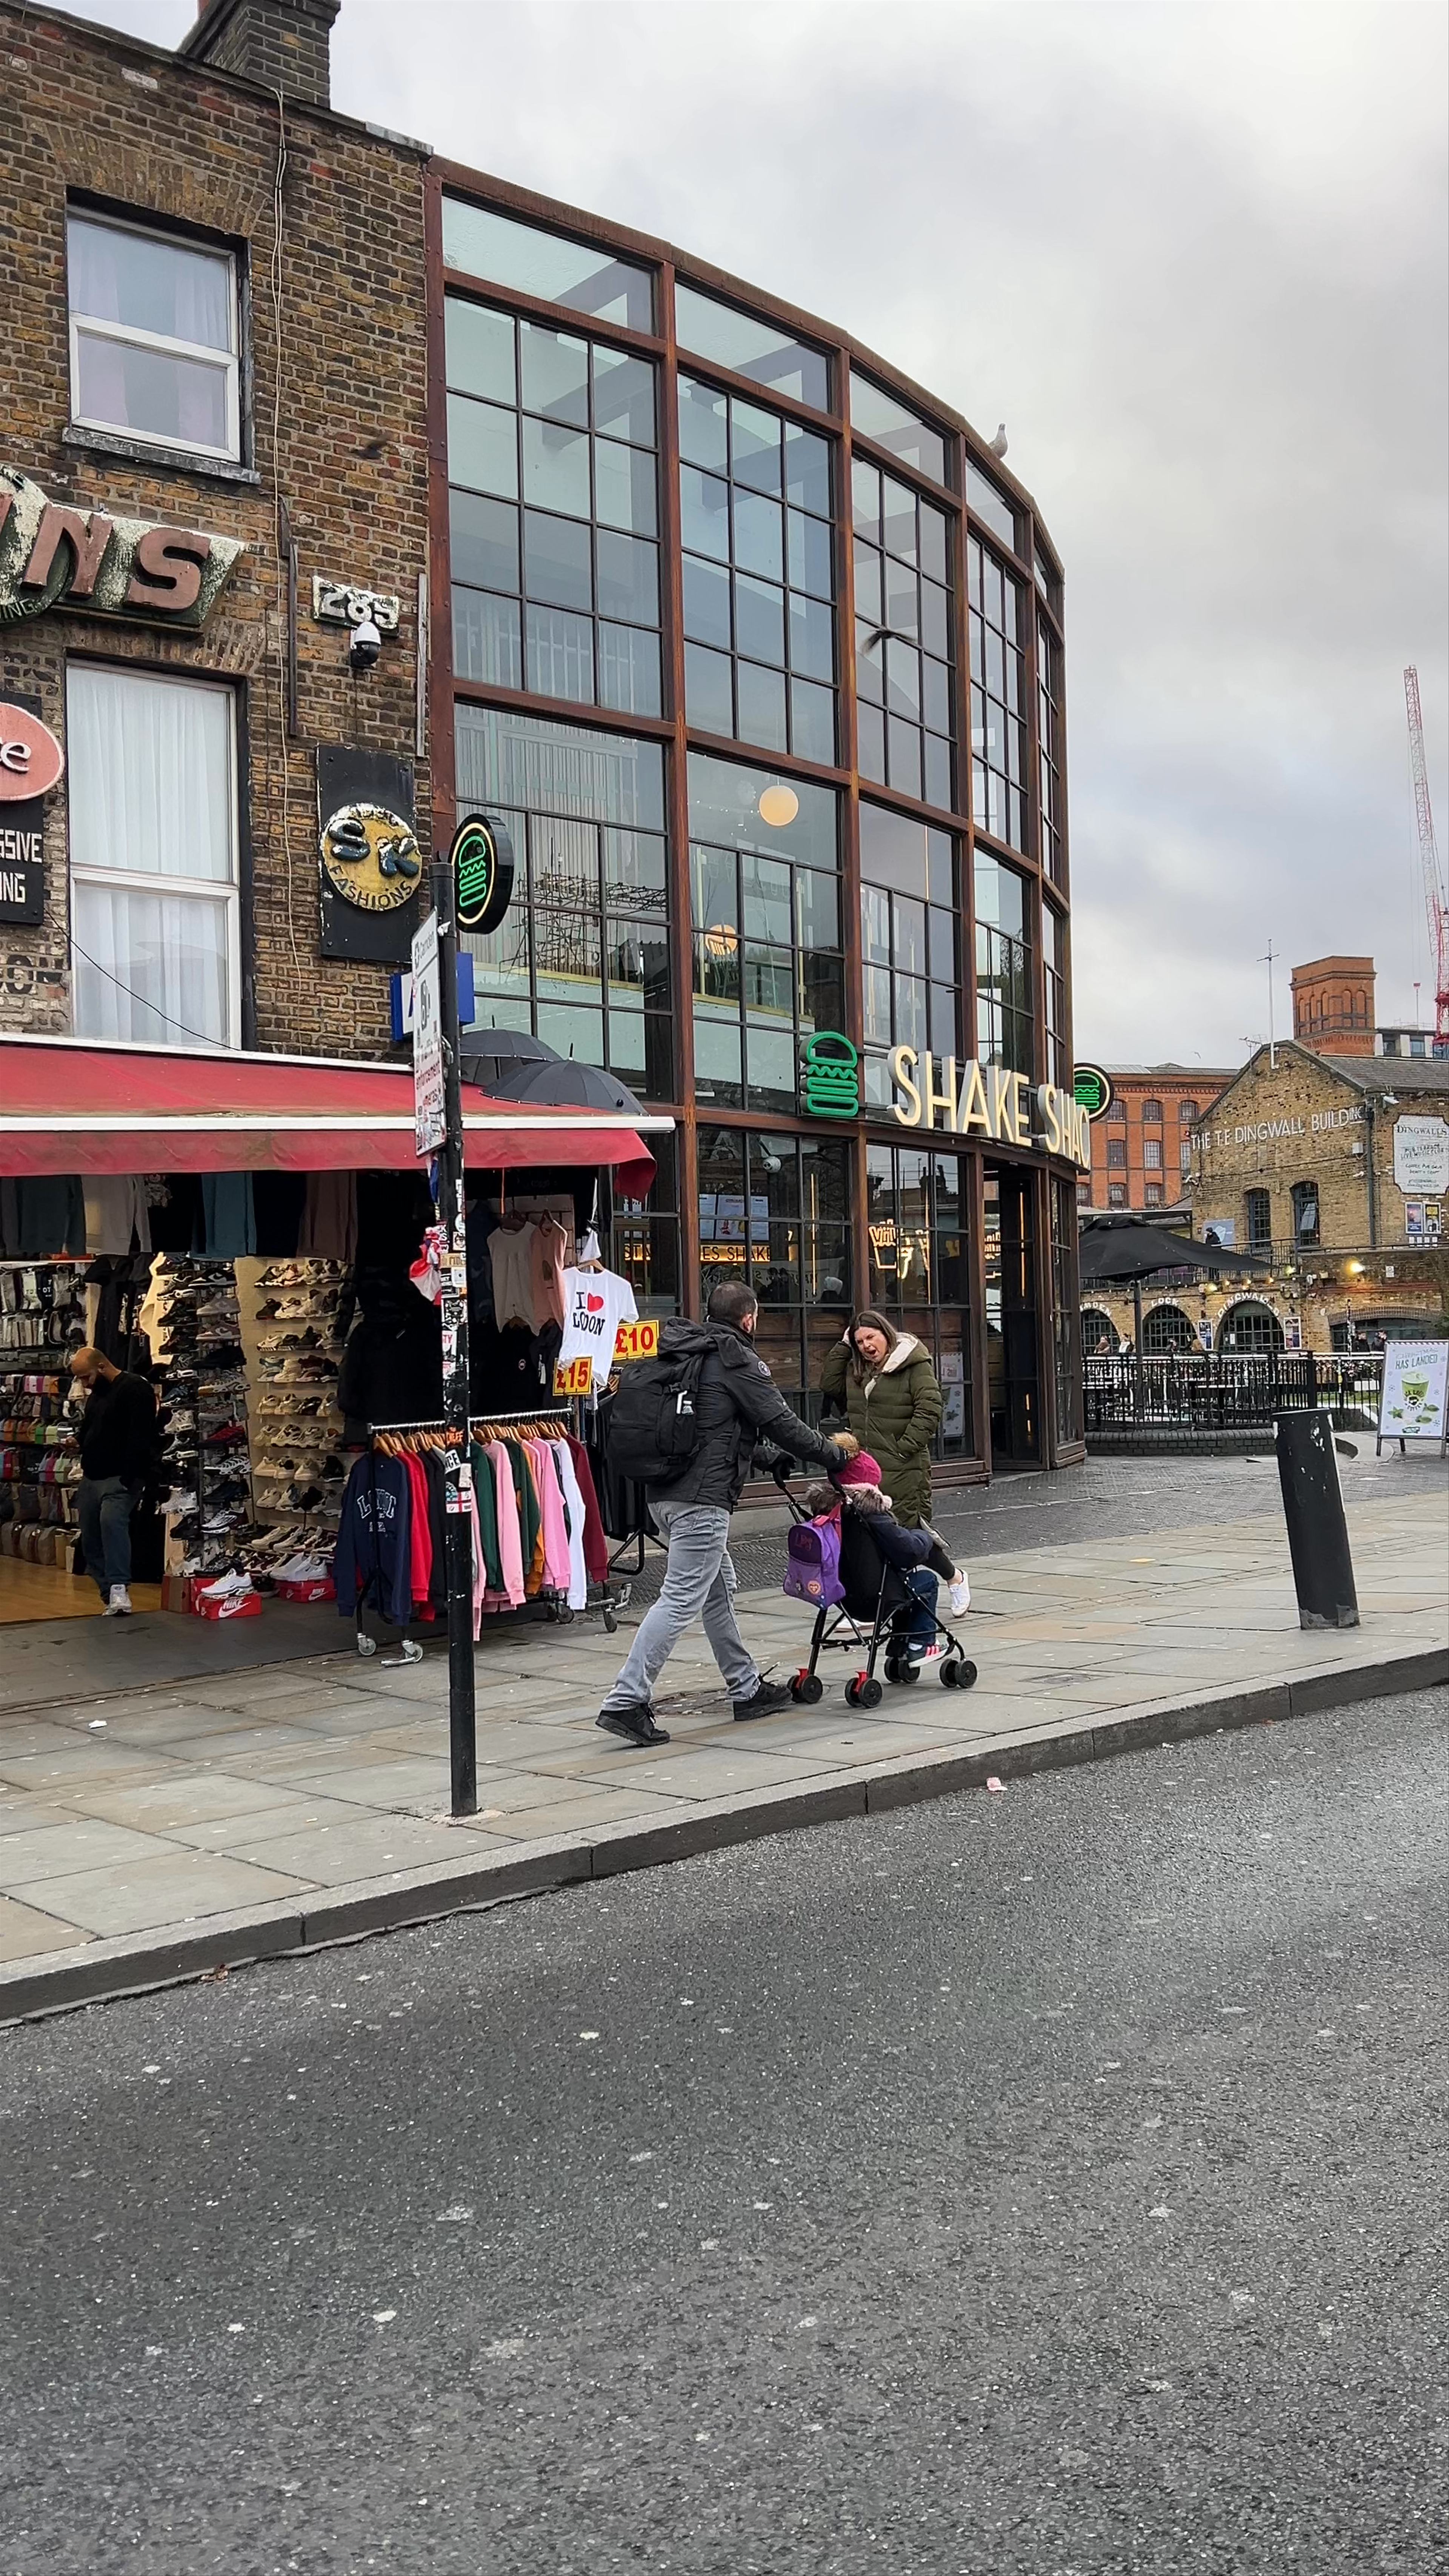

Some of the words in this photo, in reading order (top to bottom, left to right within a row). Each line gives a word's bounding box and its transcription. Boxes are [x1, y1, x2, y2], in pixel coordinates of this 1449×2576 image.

[0, 492, 211, 612] NS
[0, 598, 36, 619] ING
[320, 586, 397, 629] 285
[0, 741, 31, 772] e
[329, 865, 413, 907] FASHIONS
[886, 1045, 1032, 1147] SHAKE
[1191, 1132, 1211, 1150] THE
[1235, 1117, 1305, 1144] DINGWALL
[1311, 1106, 1365, 1131] BUILDING
[1397, 1125, 1447, 1135] DINGWALLS
[703, 1246, 720, 1260] ES
[575, 1292, 586, 1310] I
[1151, 1297, 1179, 1307] LOCK
[615, 1326, 654, 1354] £10
[557, 1361, 588, 1389] £15
[1395, 1359, 1409, 1370] HAS
[1411, 1353, 1438, 1367] LANDED
[223, 1596, 244, 1609] NIKE
